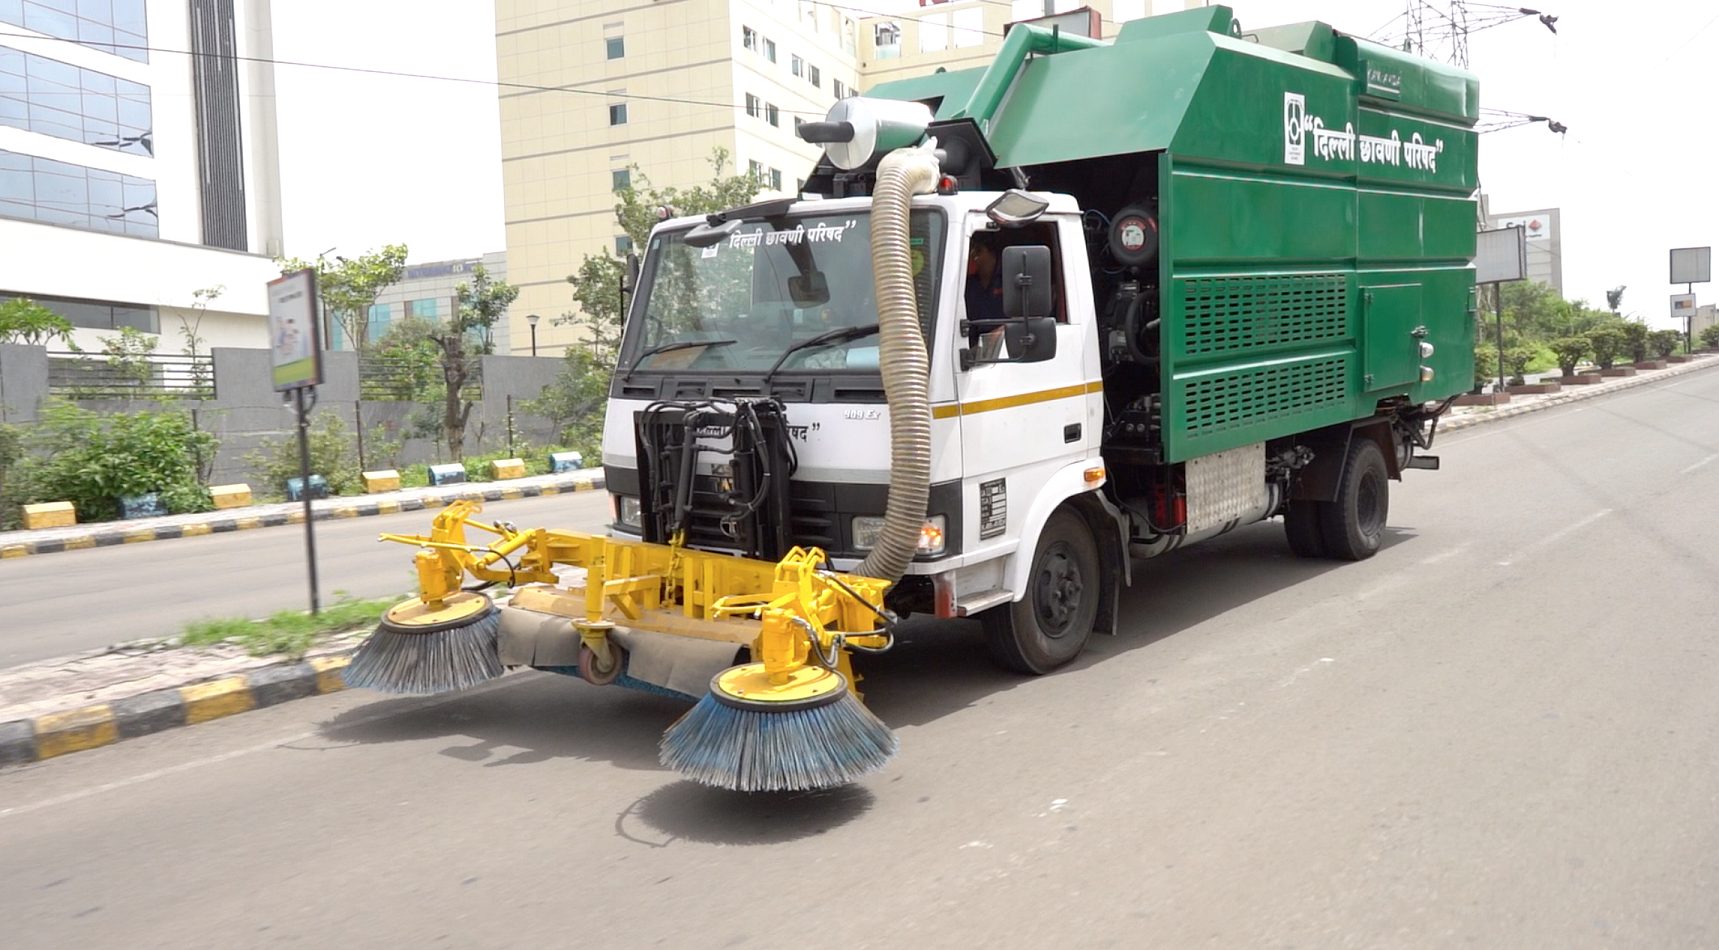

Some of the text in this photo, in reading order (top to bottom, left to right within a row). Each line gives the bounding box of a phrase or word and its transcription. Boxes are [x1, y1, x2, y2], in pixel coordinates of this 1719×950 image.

[1304, 115, 1444, 174] “दिल्ली छावणी परिषद”
[766, 224, 804, 246] छावणी
[807, 220, 857, 243] परिषद”
